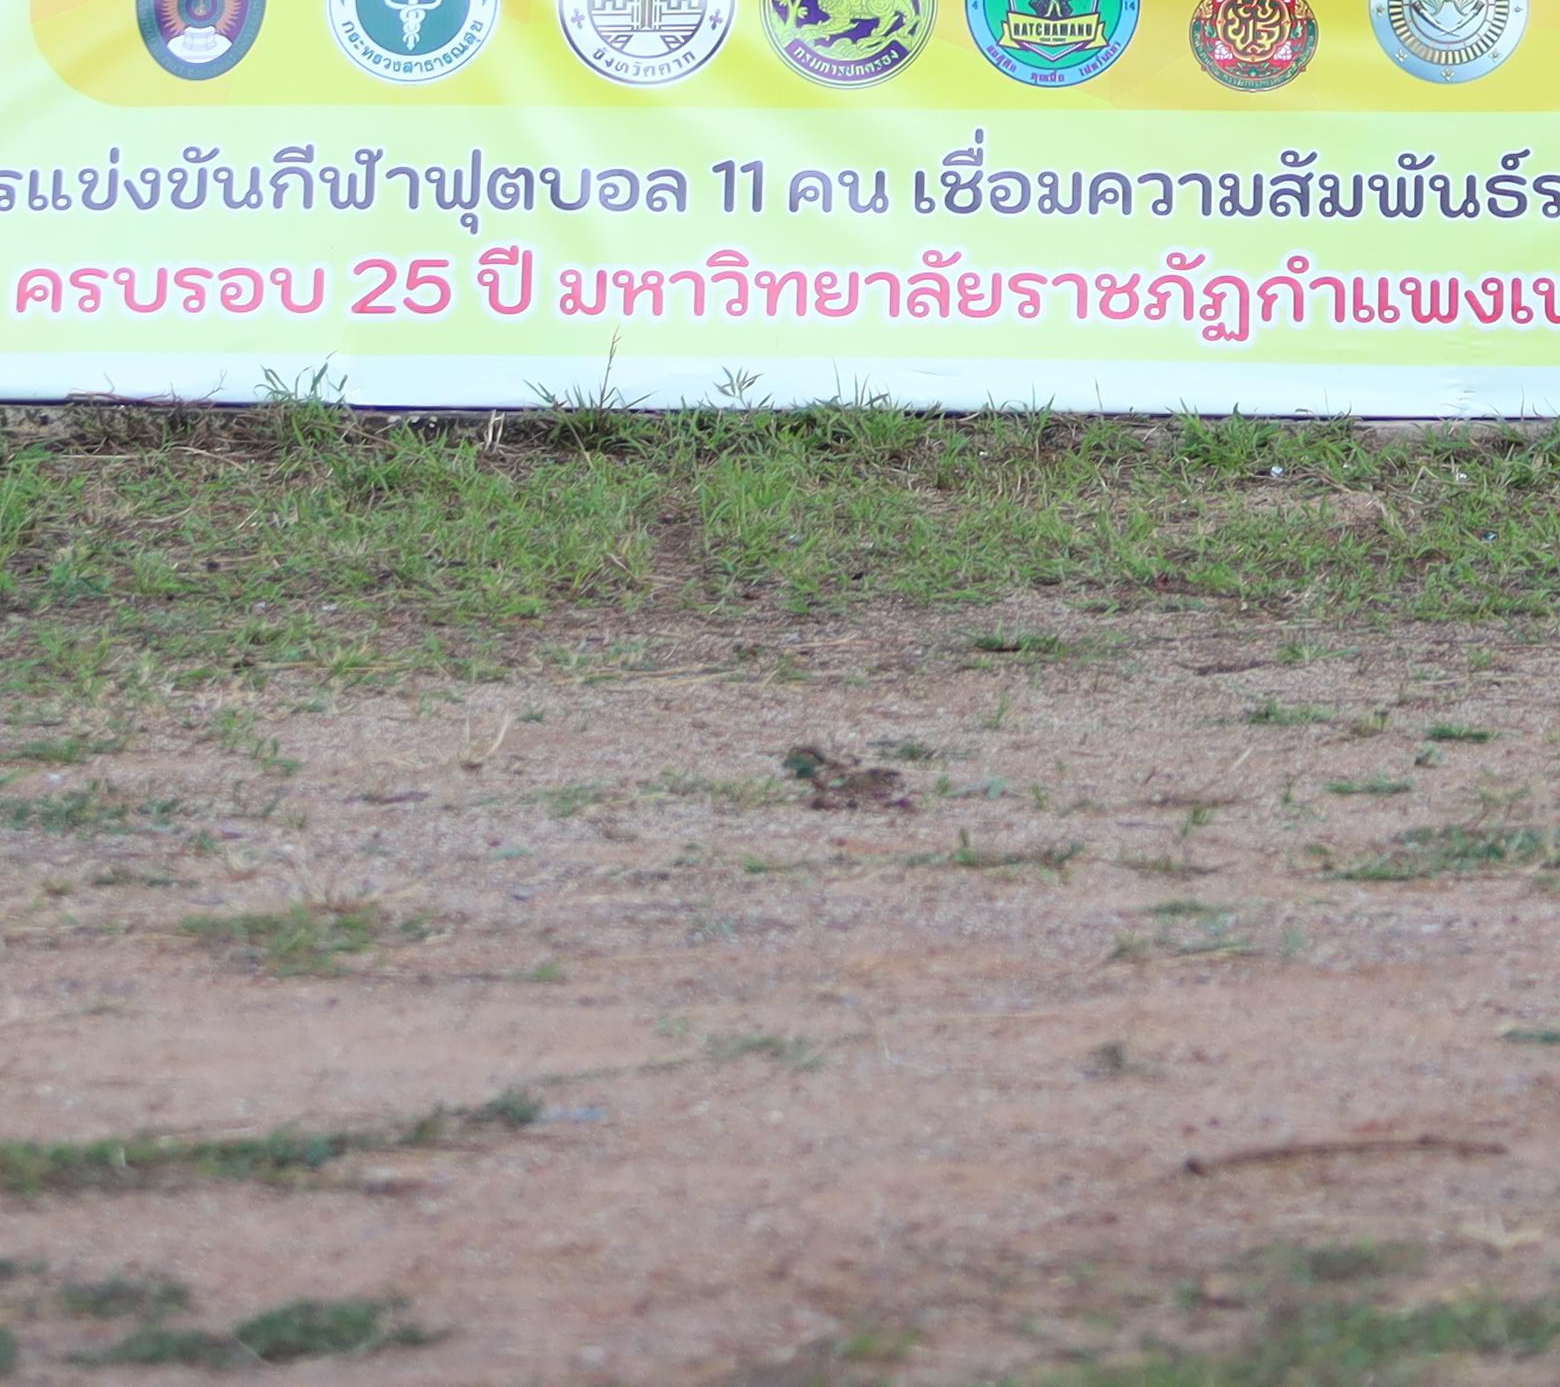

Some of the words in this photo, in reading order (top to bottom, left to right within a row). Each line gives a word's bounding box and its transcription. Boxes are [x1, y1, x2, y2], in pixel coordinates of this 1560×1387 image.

[711, 159, 764, 214] 11
[788, 167, 890, 214] คน
[15, 265, 326, 315] ครบรอบ
[350, 257, 452, 316] 25
[476, 244, 533, 316] ปี
